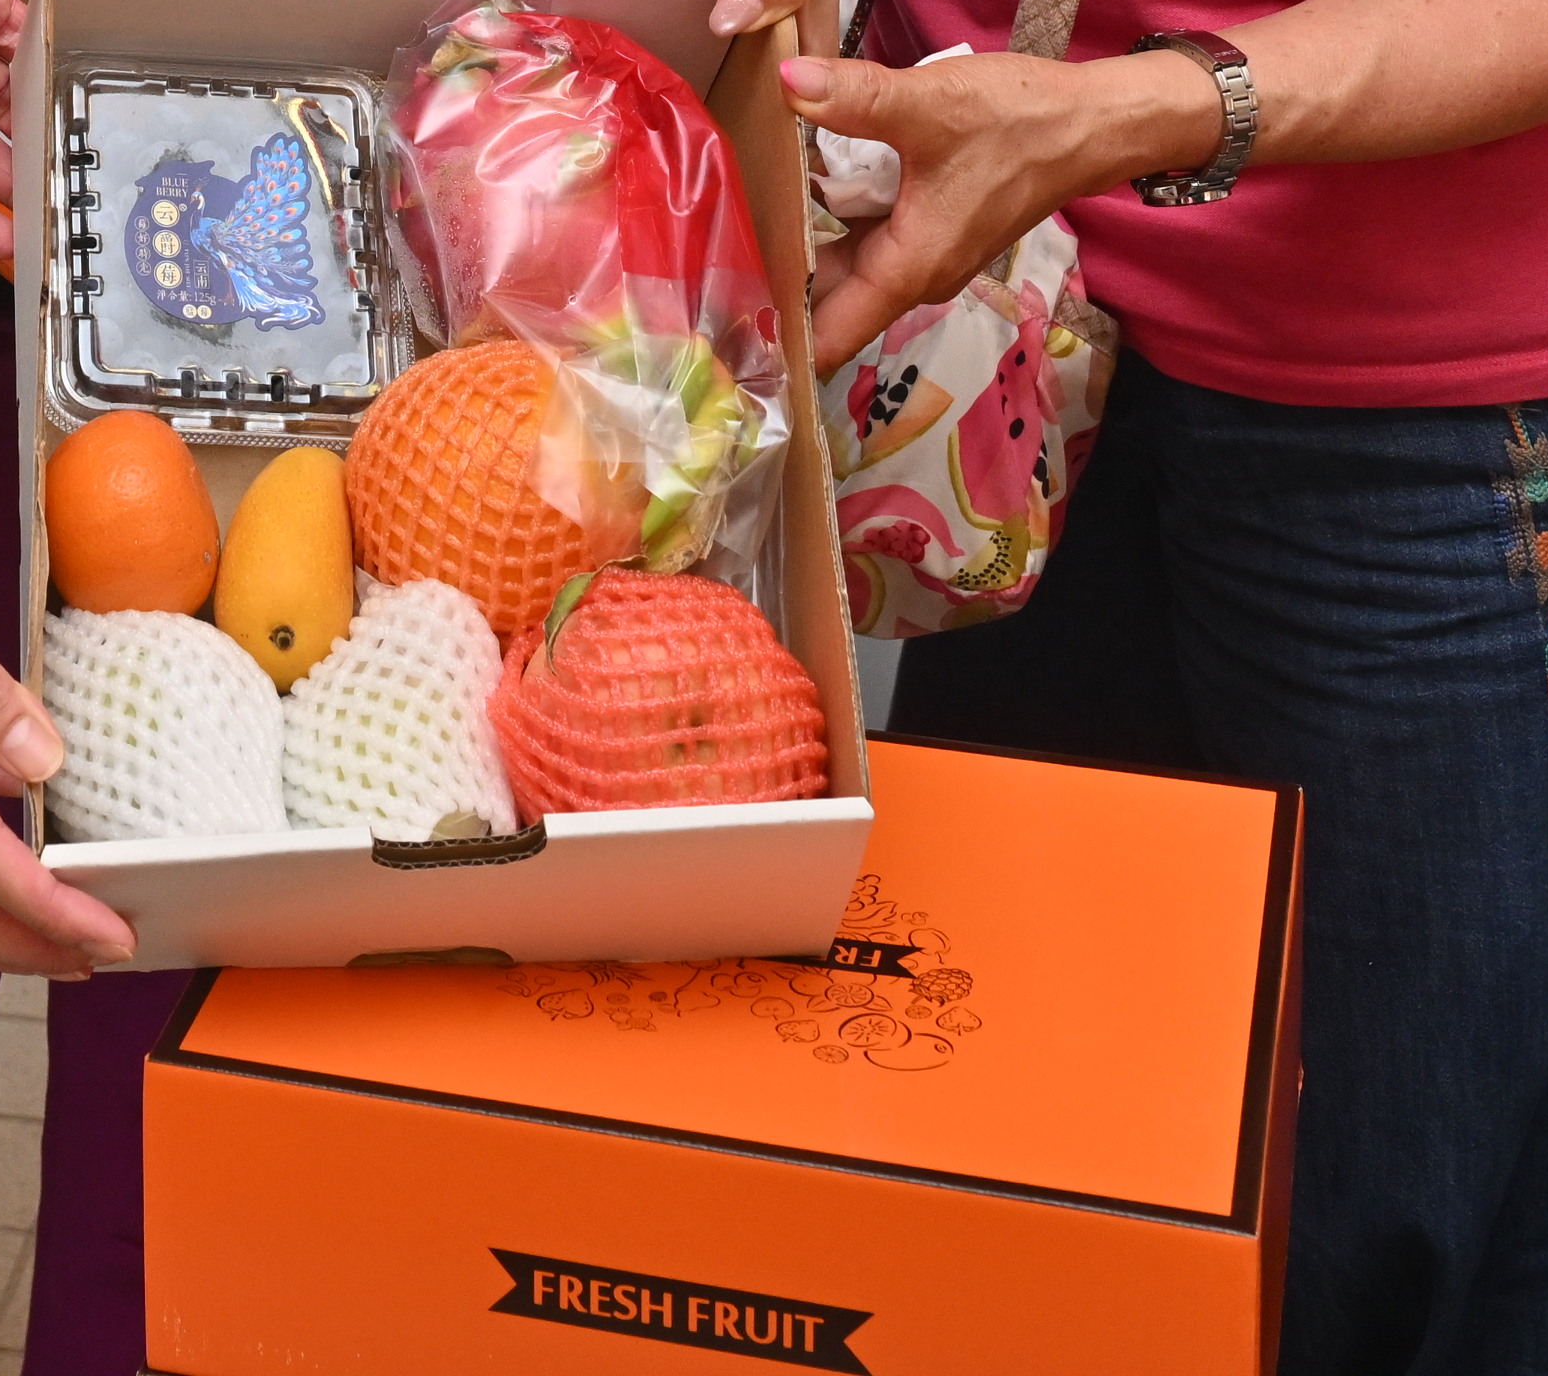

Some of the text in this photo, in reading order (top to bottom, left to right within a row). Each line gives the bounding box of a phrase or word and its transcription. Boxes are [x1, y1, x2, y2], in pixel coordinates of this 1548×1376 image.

[161, 176, 189, 188] BLUE
[156, 186, 189, 198] BERRY
[532, 1269, 825, 1353] FRESH FRUIT
